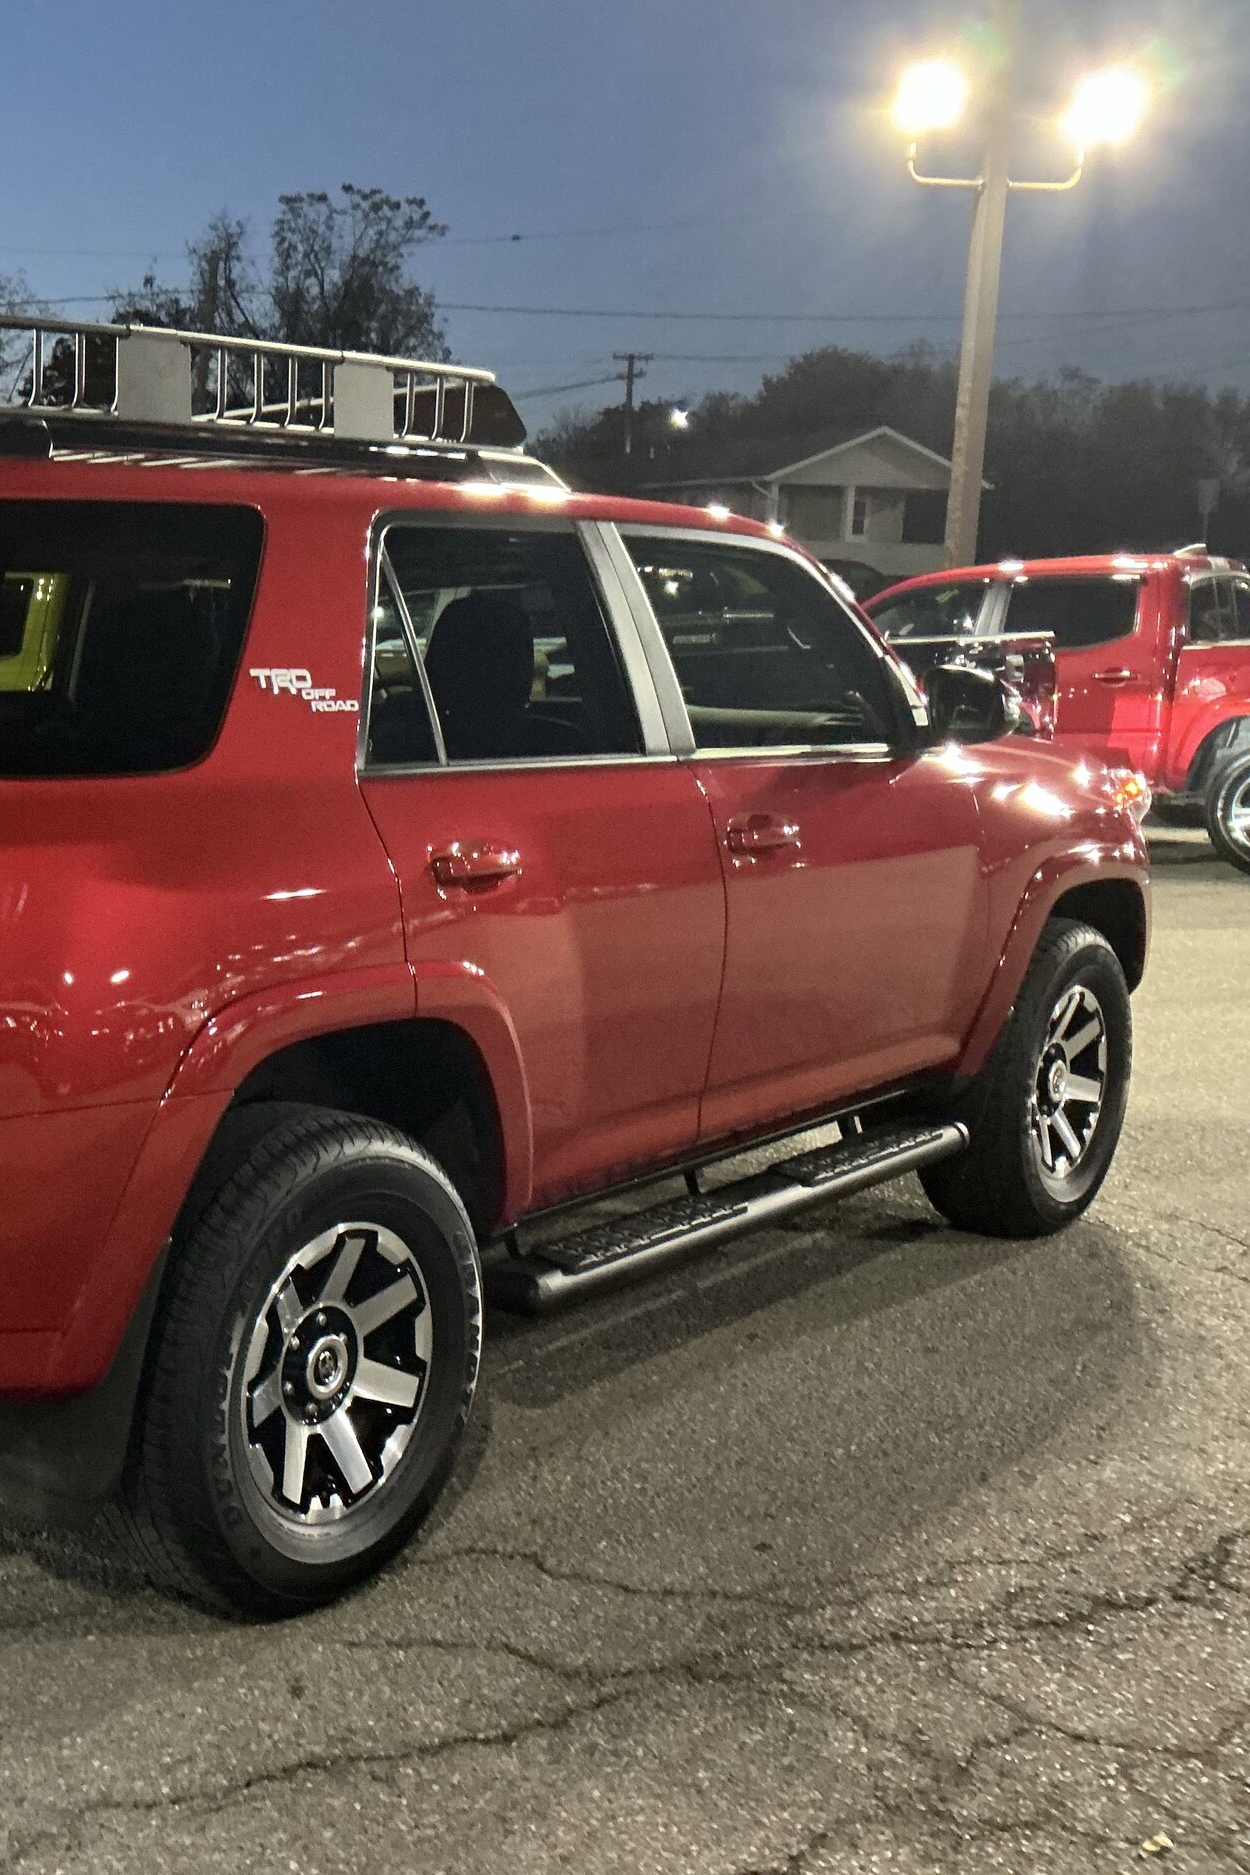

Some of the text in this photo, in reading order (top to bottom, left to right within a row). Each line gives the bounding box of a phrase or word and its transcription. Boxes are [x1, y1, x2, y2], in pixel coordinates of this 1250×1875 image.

[249, 668, 312, 695] TRD
[301, 688, 336, 700] OFF
[311, 699, 359, 712] ROAD
